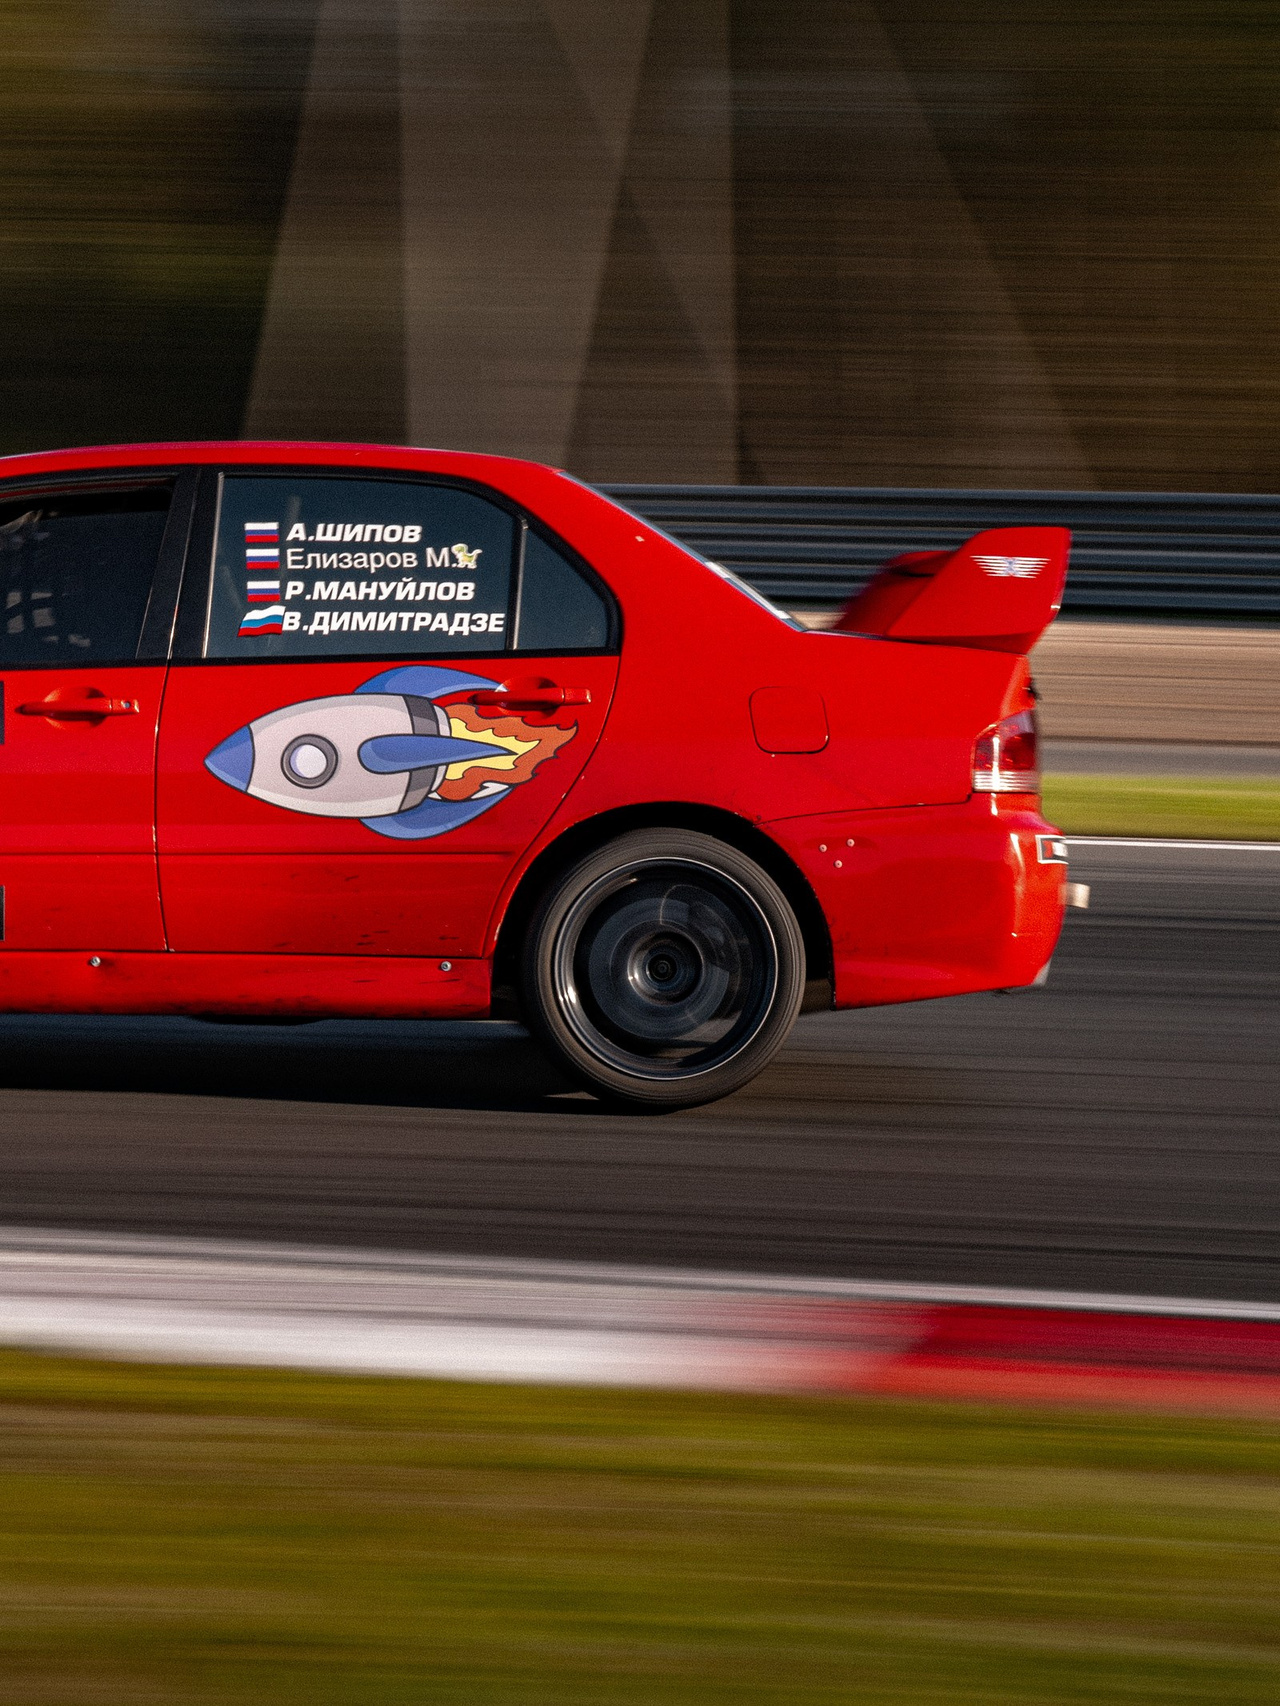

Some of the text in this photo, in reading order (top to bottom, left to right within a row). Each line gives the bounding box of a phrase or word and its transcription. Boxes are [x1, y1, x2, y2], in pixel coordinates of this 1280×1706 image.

[285, 522, 422, 543] А.ШИПОВ
[286, 547, 418, 573] Елизаров
[284, 577, 475, 601] Р.МАНУЙЛОВ
[282, 612, 505, 636] В.ДИМИТРАДЗЕ
